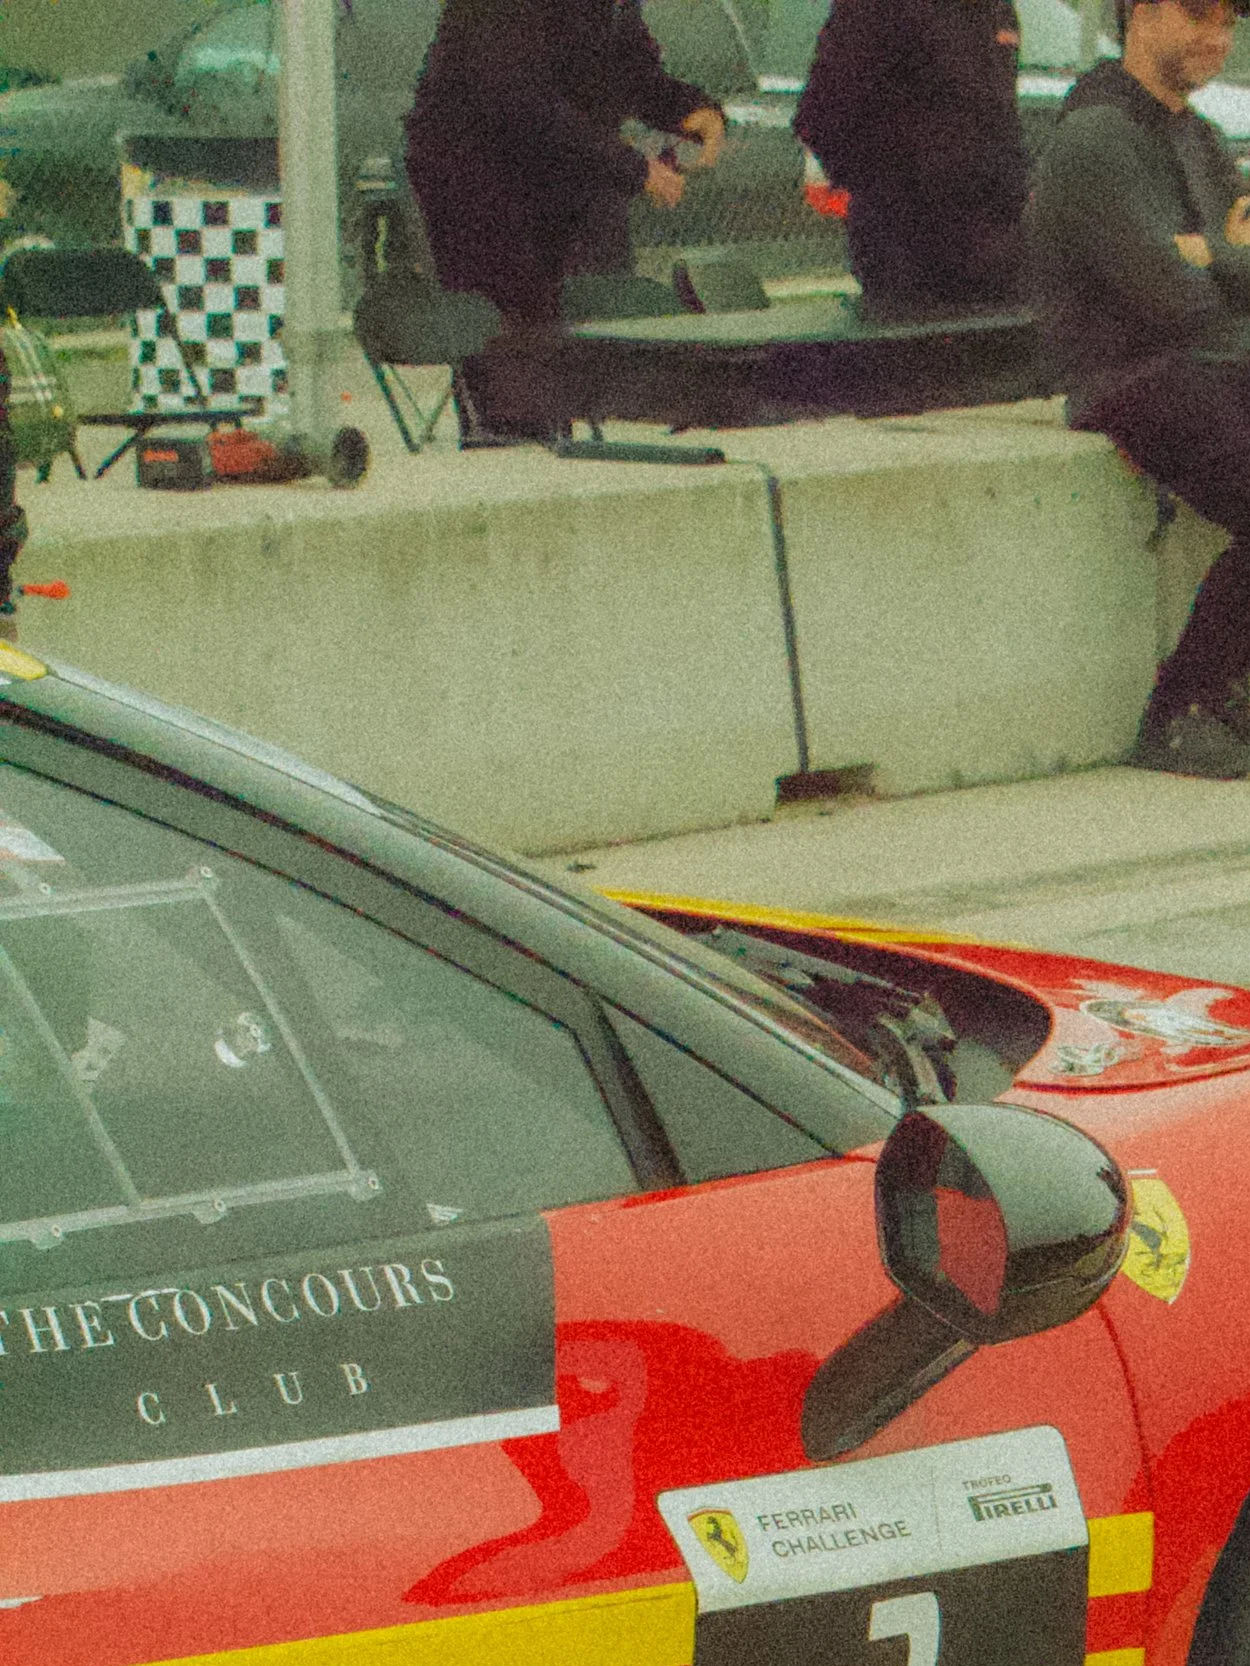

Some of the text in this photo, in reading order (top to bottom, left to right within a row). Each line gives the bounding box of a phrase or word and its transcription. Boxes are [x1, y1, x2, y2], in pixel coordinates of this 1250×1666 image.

[128, 1259, 455, 1342] CONCOURS
[962, 1475, 1012, 1491] TROFEO
[757, 1502, 858, 1532] FERRARI
[968, 1483, 1059, 1522] PIRELLI
[771, 1521, 912, 1558] CHALLENGE
